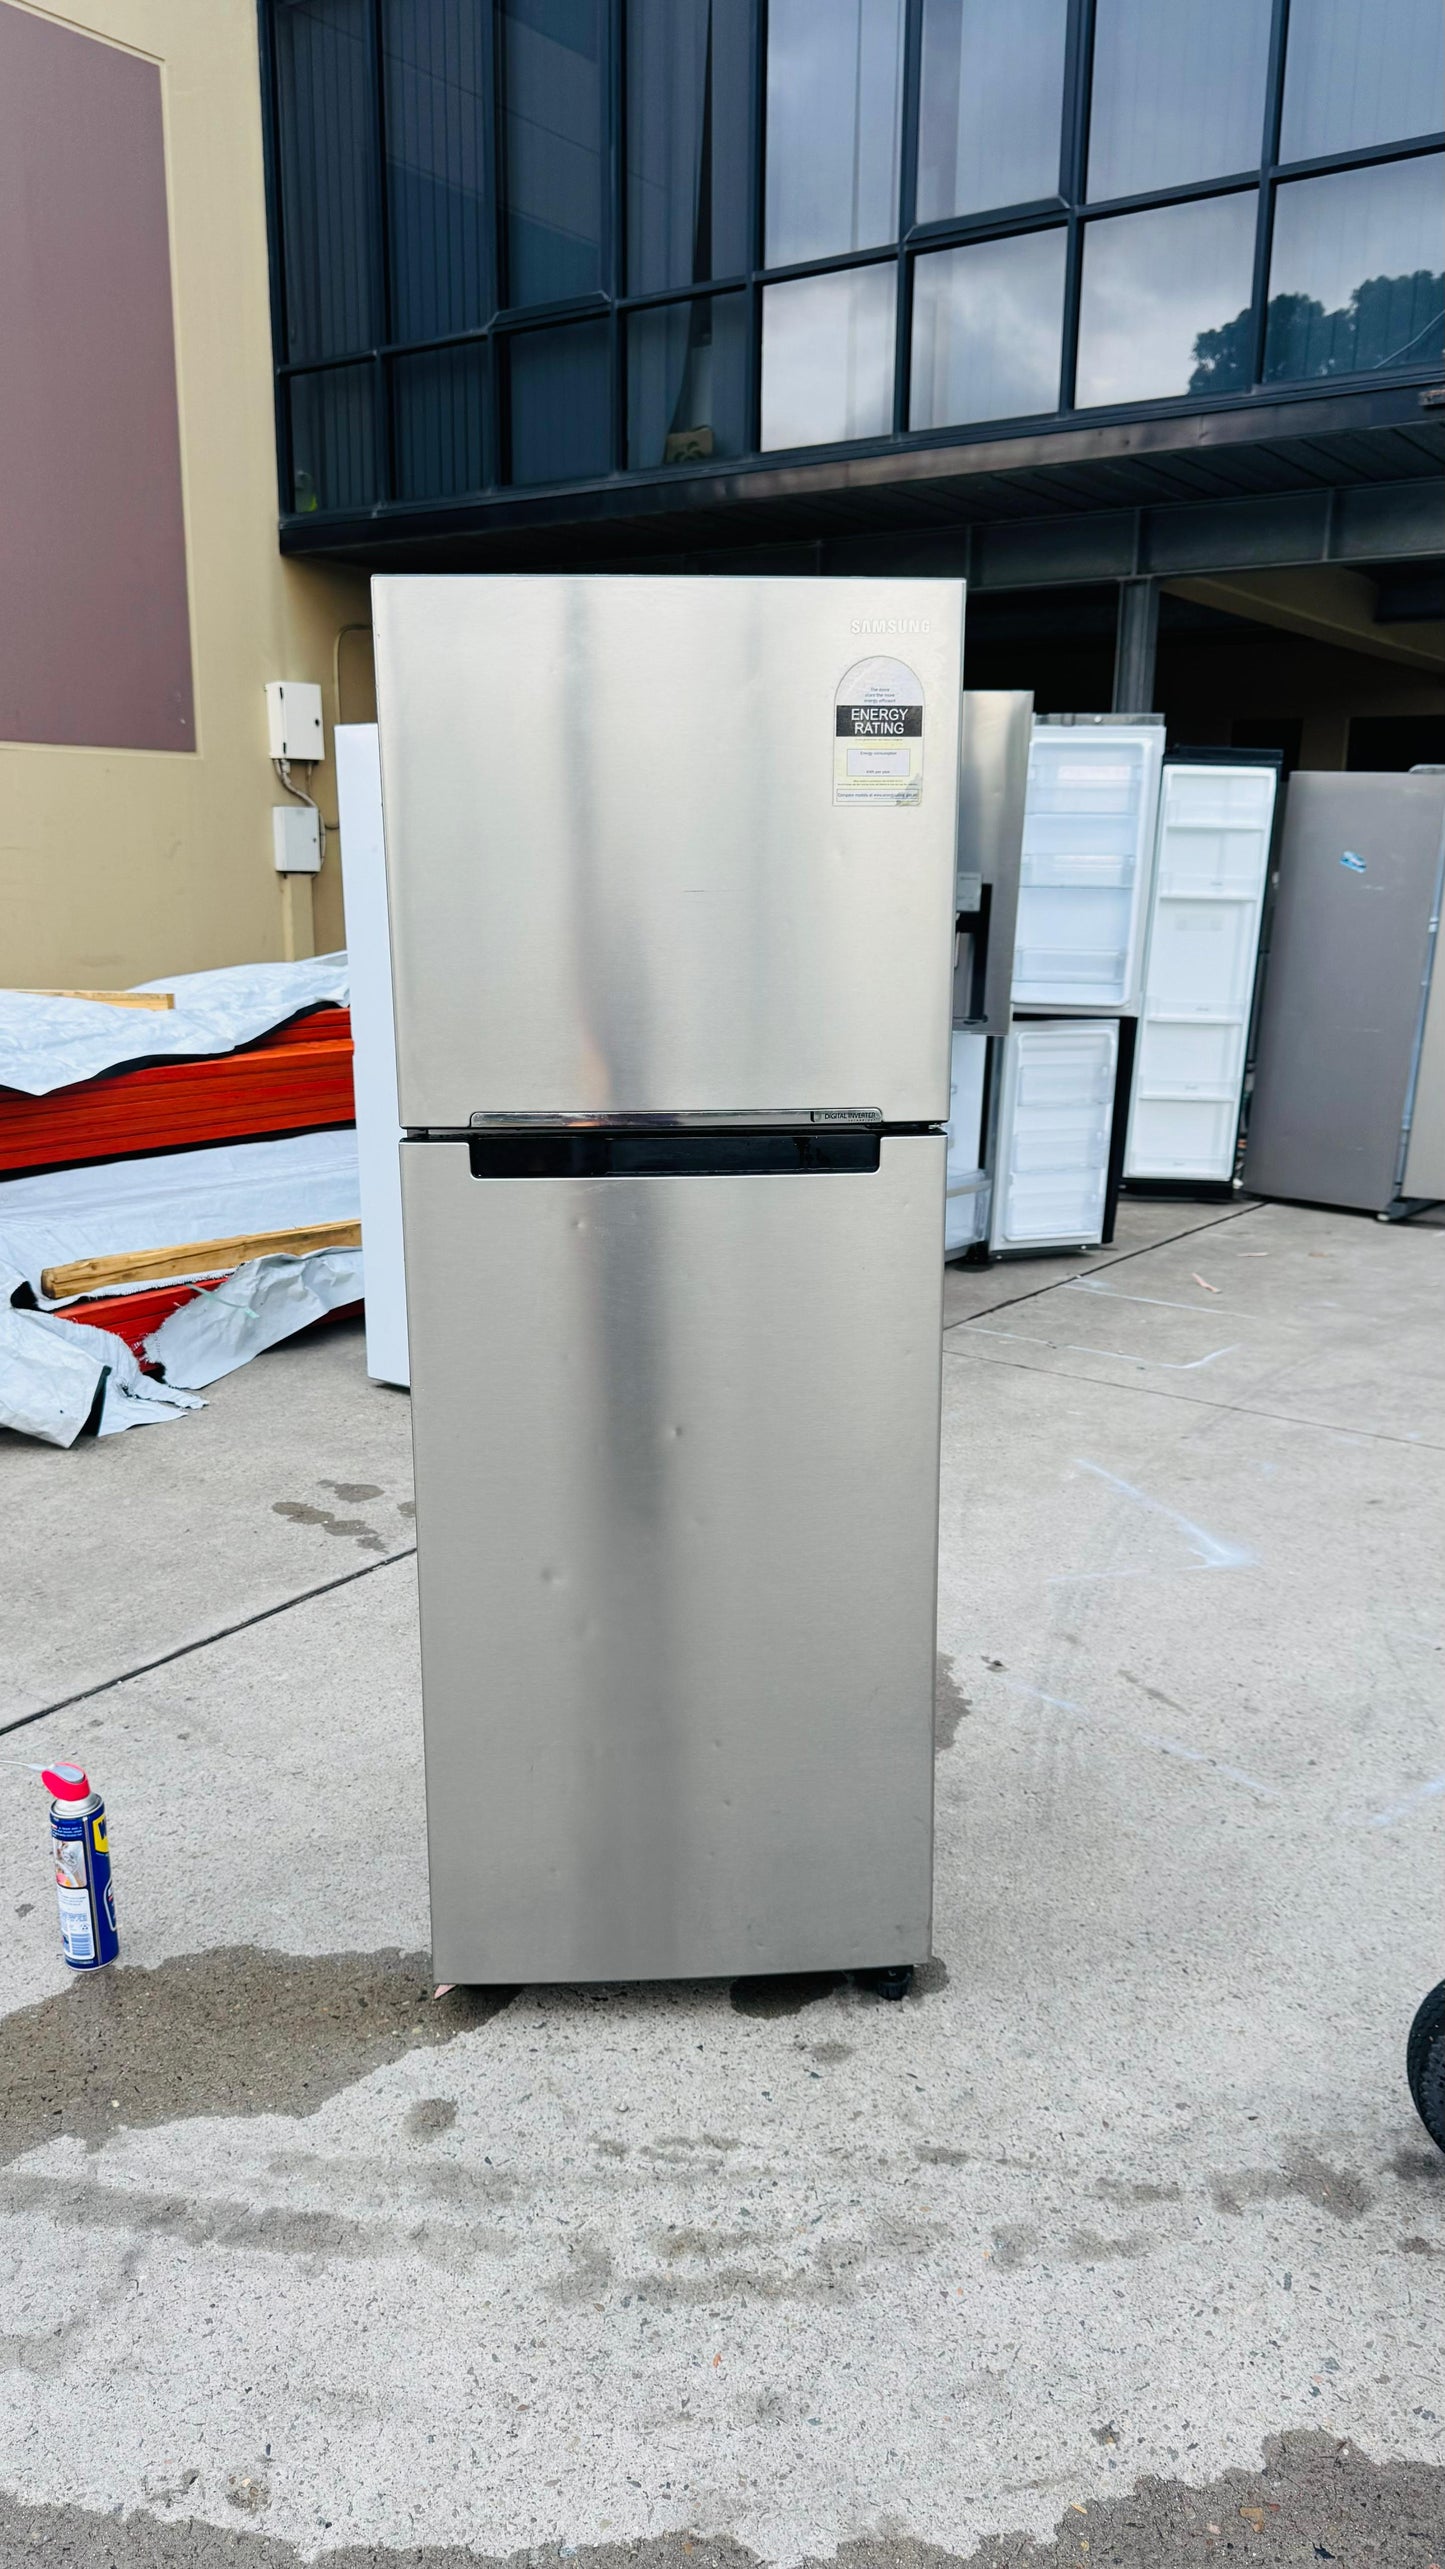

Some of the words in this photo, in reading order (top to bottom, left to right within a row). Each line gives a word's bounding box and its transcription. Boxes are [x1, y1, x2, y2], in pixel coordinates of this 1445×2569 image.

[851, 619, 930, 634] SAMSUNG
[851, 708, 909, 721] ENERGY
[854, 722, 905, 735] RATING
